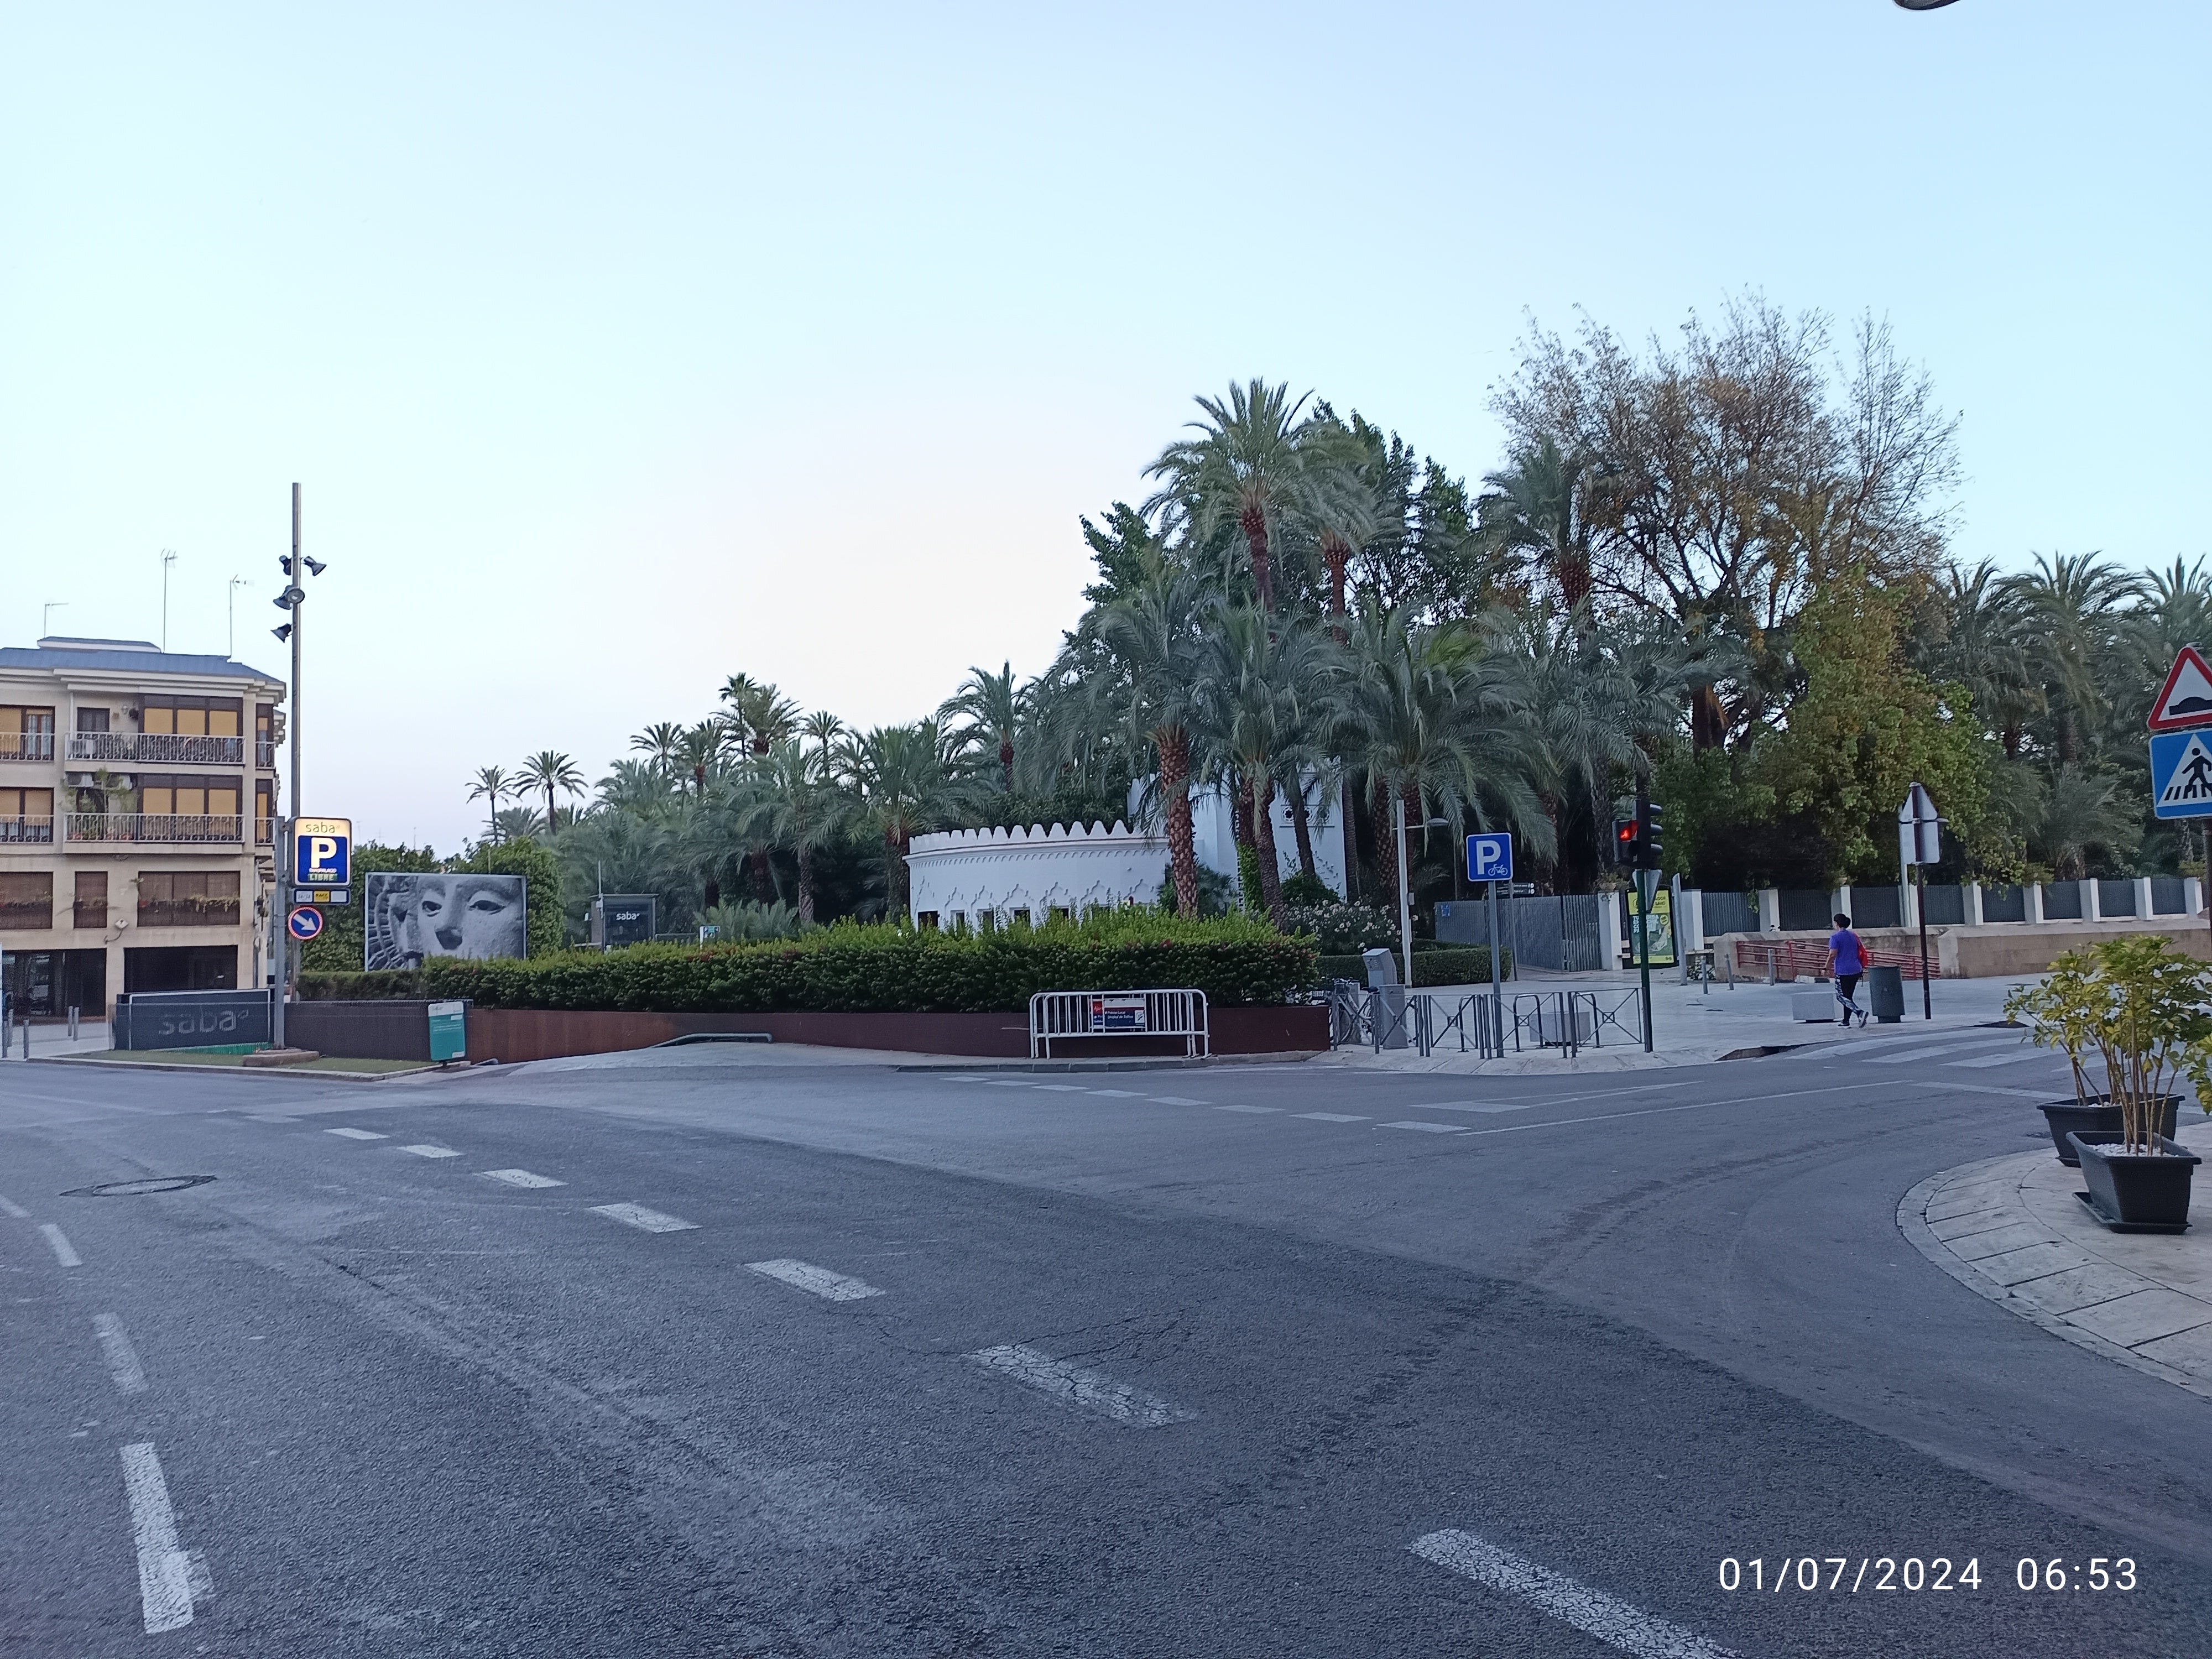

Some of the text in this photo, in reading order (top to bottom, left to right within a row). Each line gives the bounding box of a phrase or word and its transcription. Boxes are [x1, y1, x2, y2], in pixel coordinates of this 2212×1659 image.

[305, 822, 335, 833] saba
[311, 837, 337, 868] P
[1476, 840, 1501, 875] P
[616, 911, 637, 920] saba
[159, 1006, 237, 1035] saba
